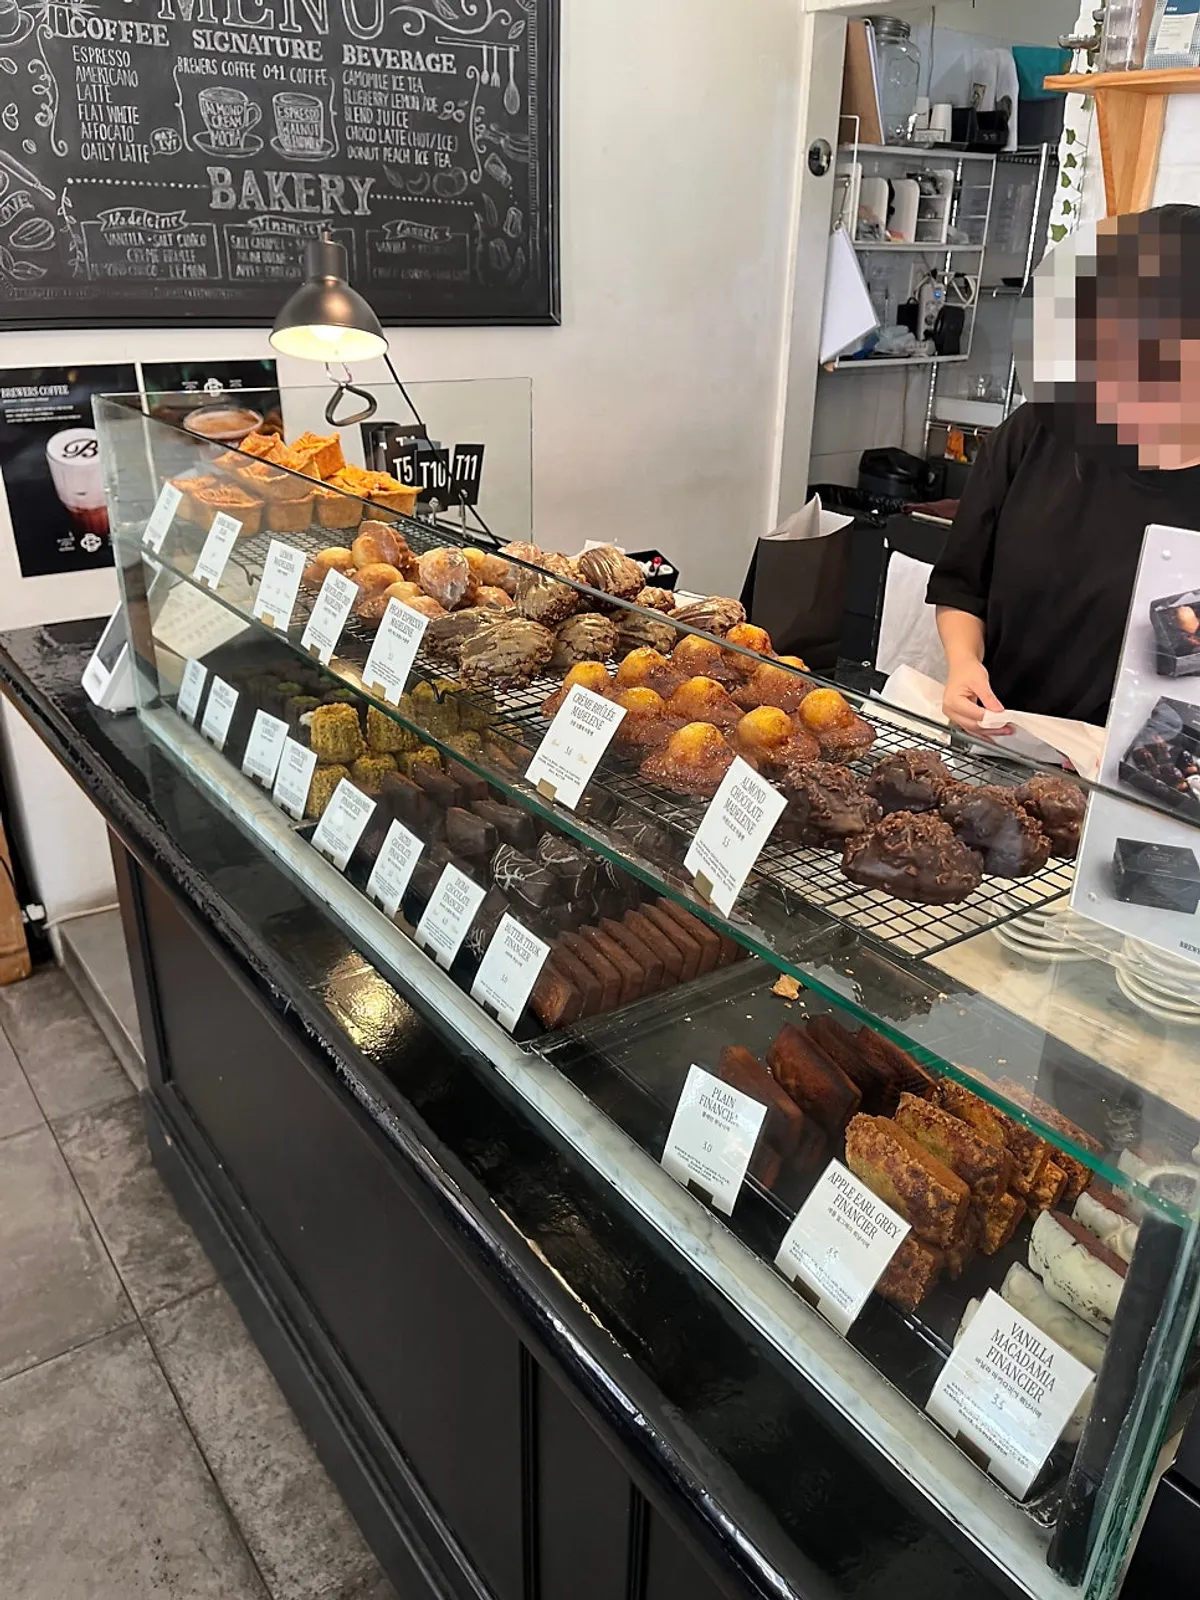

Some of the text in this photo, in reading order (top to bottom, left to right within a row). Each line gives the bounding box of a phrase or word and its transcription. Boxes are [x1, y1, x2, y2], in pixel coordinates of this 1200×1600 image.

[70, 16, 170, 47] COFFEE
[72, 45, 131, 68] ESPRESSO
[192, 29, 323, 61] SIGNATURE
[178, 56, 328, 86] BREWERS COFFEE 041 COFFEE
[342, 44, 456, 74] BEVERAGE
[75, 65, 138, 87] AMERICANO
[342, 70, 424, 93] CAMOMILE ICE TEA
[76, 83, 112, 103] LATTE
[343, 87, 388, 107] BLUEBERRY
[391, 93, 420, 110] LEMON
[78, 104, 140, 124] FLAT WHITE
[205, 102, 243, 116] ALMOND
[211, 115, 242, 128] CREAM
[277, 105, 321, 121] ESPRESSO
[344, 106, 409, 129] BLEND JUICE
[80, 142, 150, 163] OATLY LATTE
[382, 147, 411, 164] PEACH
[414, 149, 429, 166] ICE
[206, 166, 376, 216] BAKERY
[392, 456, 413, 482] T5
[419, 461, 446, 489] T10
[456, 455, 478, 480] T11
[569, 705, 605, 731] MADELEINE
[739, 773, 767, 805] ALMOND
[722, 796, 756, 836] MADELEINE
[729, 783, 764, 823] CHOCOLATE
[441, 891, 465, 915] FINANCIER
[444, 881, 471, 907] CHOCOLATE
[503, 921, 525, 944] BUTTER
[503, 934, 531, 963] FINANCIER
[710, 1086, 736, 1110] PLAIN
[827, 1168, 901, 1241] APPLE EARL GREY
[832, 1192, 878, 1240] FINANCIER
[1007, 1321, 1057, 1369] VANILLA
[973, 1356, 991, 1374] 바닐라
[989, 1328, 1058, 1392] MACADAMIA
[984, 1344, 1046, 1404] FINANCIER
